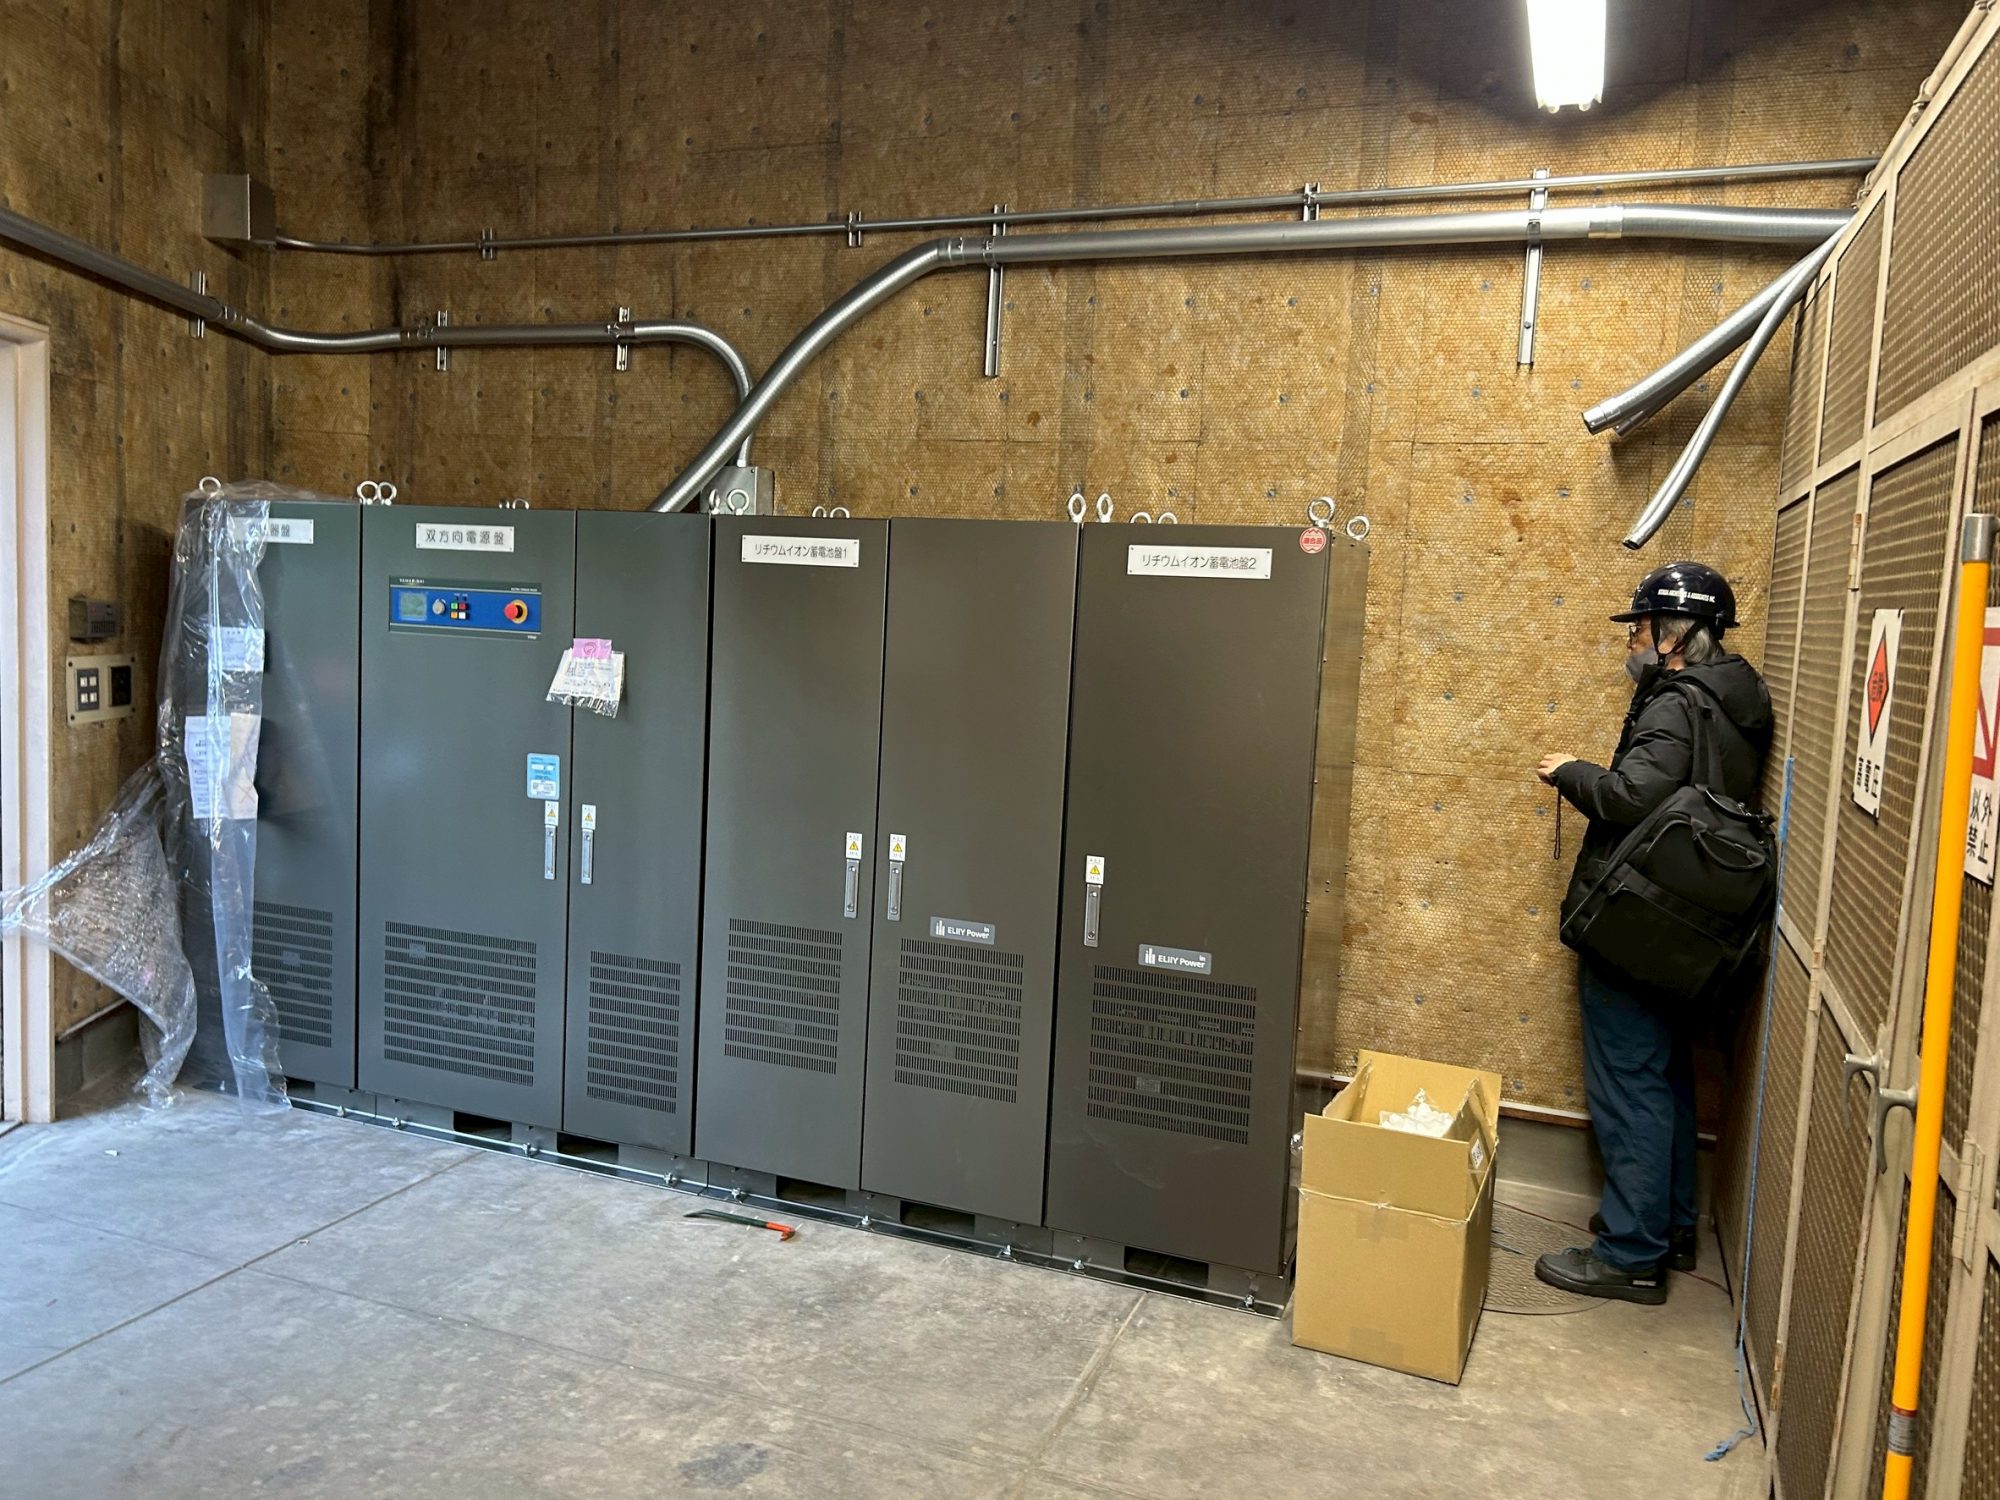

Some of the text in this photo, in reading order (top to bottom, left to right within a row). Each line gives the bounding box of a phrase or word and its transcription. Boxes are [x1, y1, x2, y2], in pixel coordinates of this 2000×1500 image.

[425, 528, 504, 545] 双方向電源盤
[755, 543, 847, 559] リチウムイオン蓄電池盤1
[1142, 554, 1257, 570] リチウムイオン蓄電池盤2
[966, 928, 990, 939] Power
[1179, 957, 1206, 969] Power
